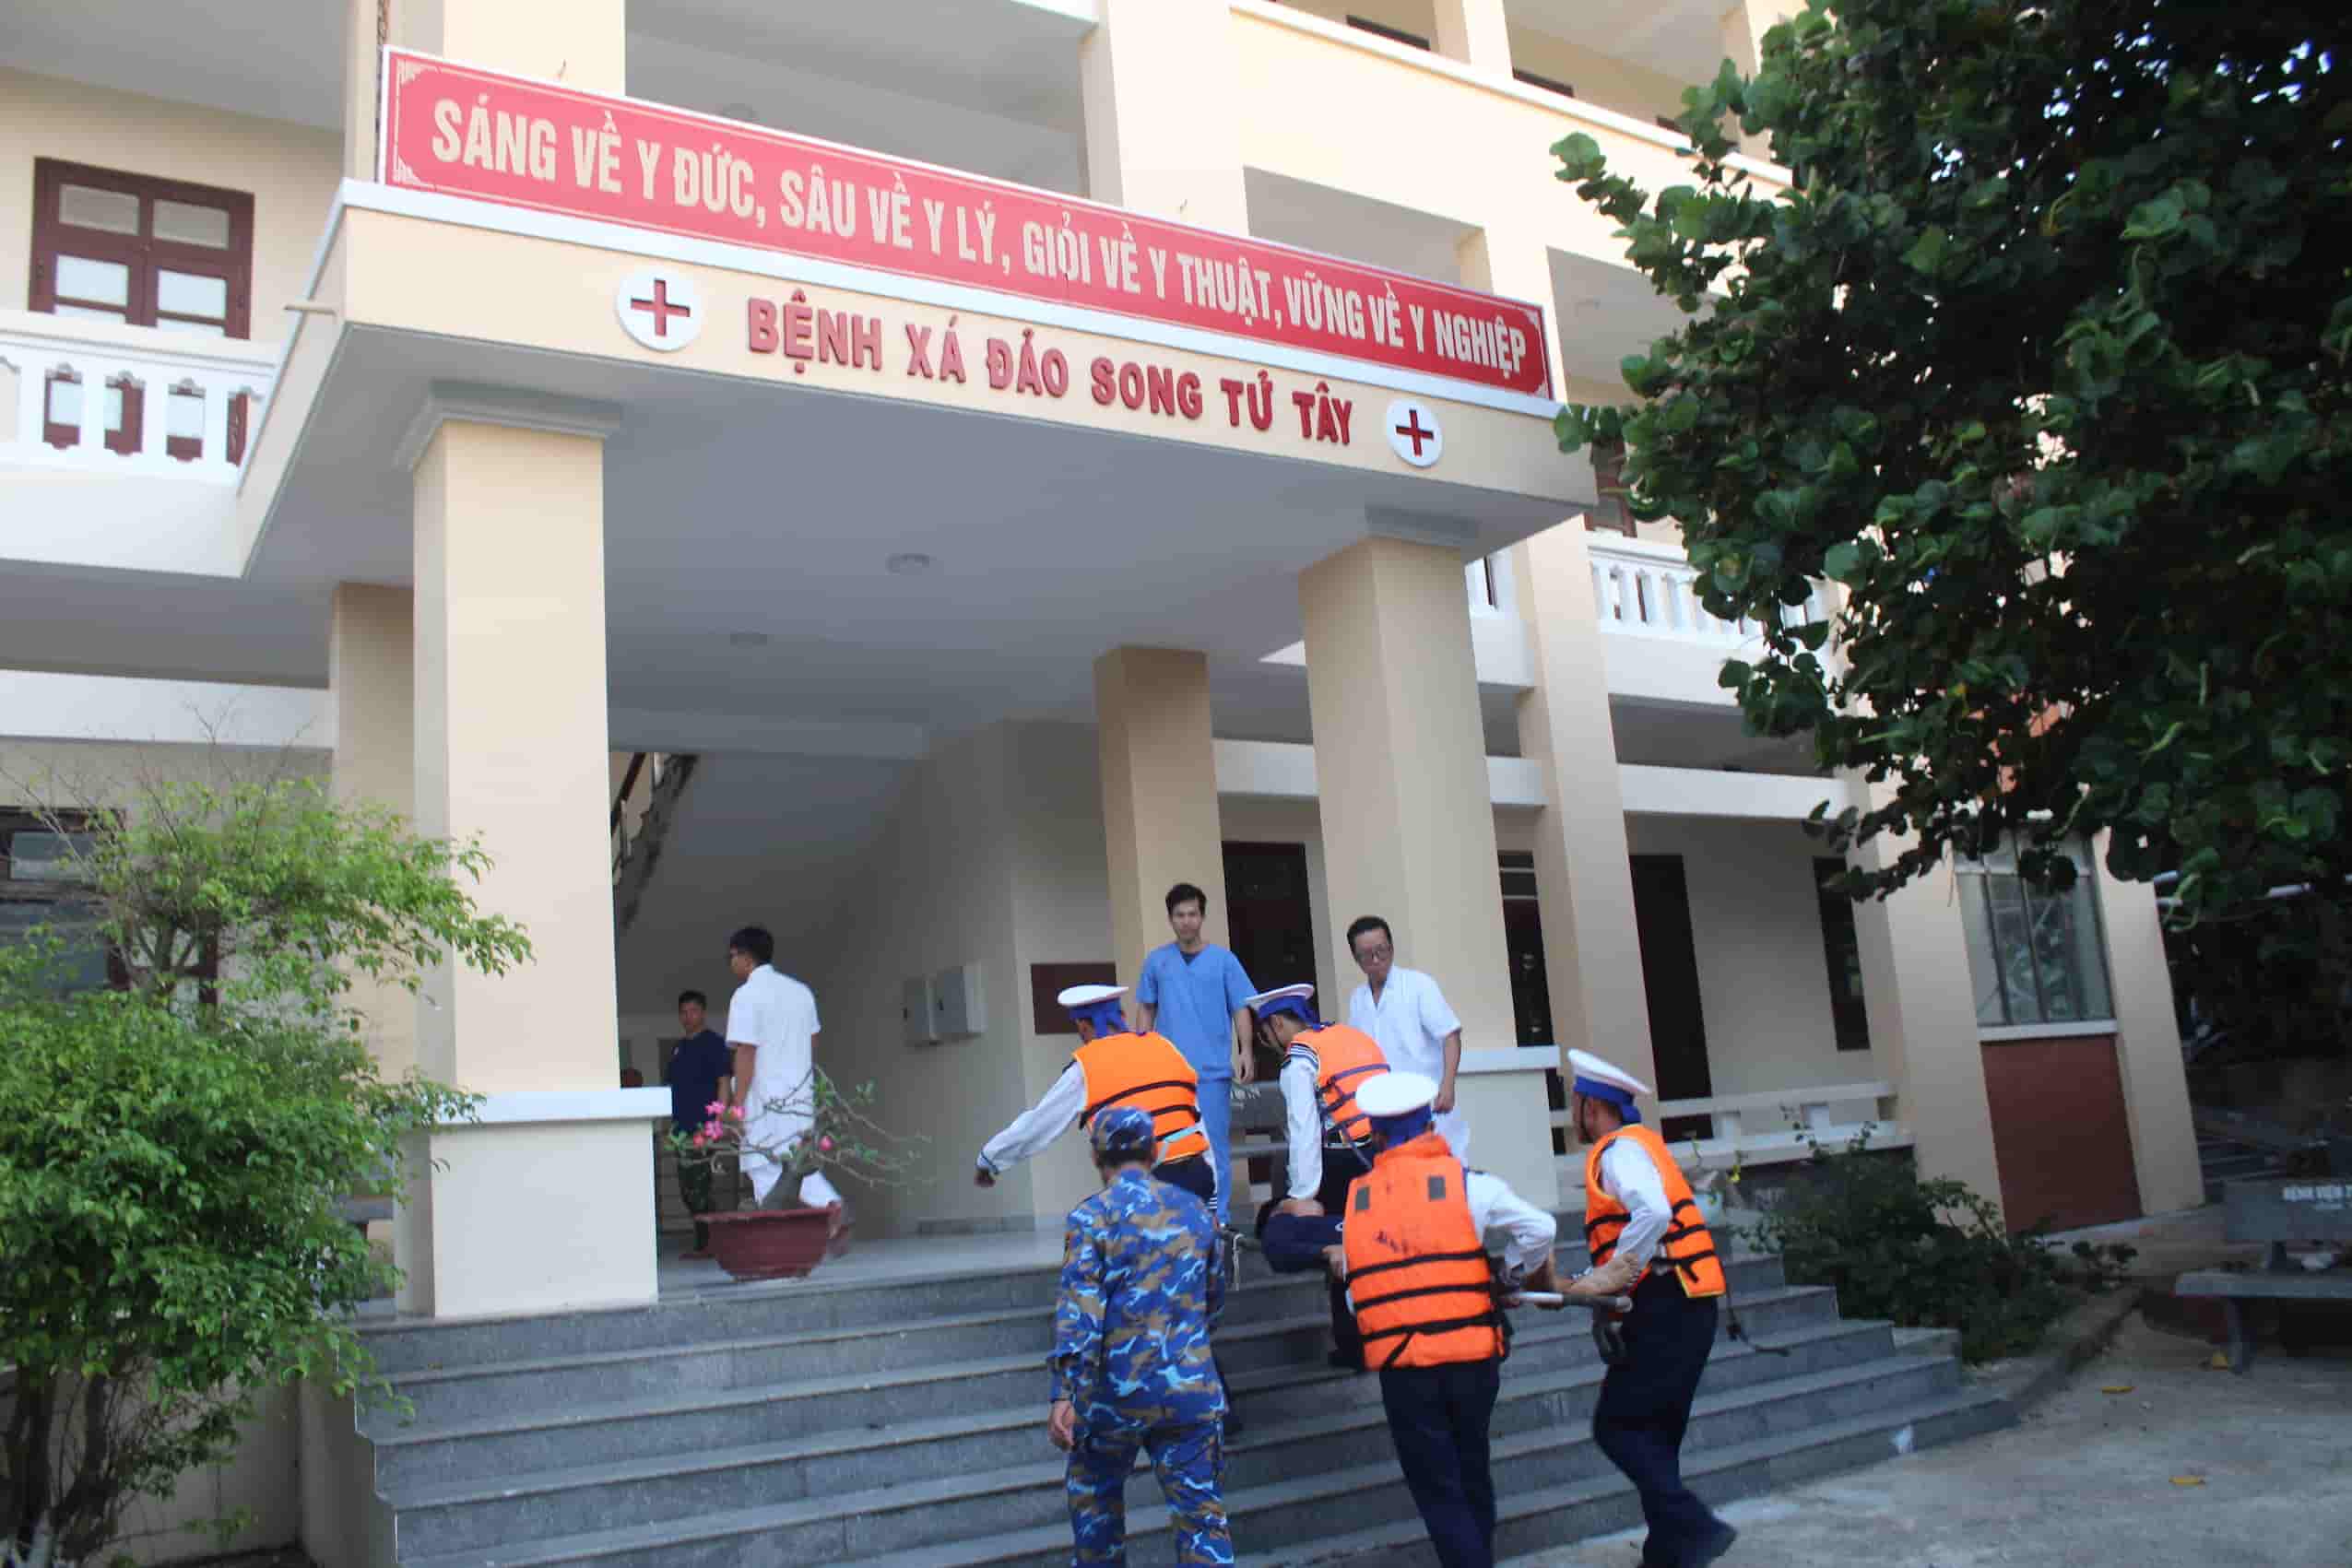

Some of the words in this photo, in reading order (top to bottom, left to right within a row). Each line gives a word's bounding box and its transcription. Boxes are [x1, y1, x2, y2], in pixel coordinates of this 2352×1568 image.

[432, 94, 557, 182] SÁNG
[572, 111, 622, 193] VỀ
[637, 139, 660, 200] Y
[673, 143, 766, 229] ĐỨC,
[780, 165, 857, 238] SÂU
[868, 172, 914, 249] VỀ
[923, 198, 945, 254] Y
[957, 200, 1011, 276] LÝ,
[1022, 210, 1092, 283] GIỎI
[1100, 221, 1141, 294] VỀ
[1148, 248, 1166, 299] Y
[1368, 281, 1403, 348] VỀ
[1410, 306, 1425, 352] Y
[1434, 310, 1526, 378] NGHIỆP
[747, 290, 882, 376] BỆNH
[906, 316, 966, 384] XÁ
[986, 328, 1069, 398] ĐẢO
[1091, 358, 1203, 420] SONG
[1291, 381, 1353, 445] TÂY
